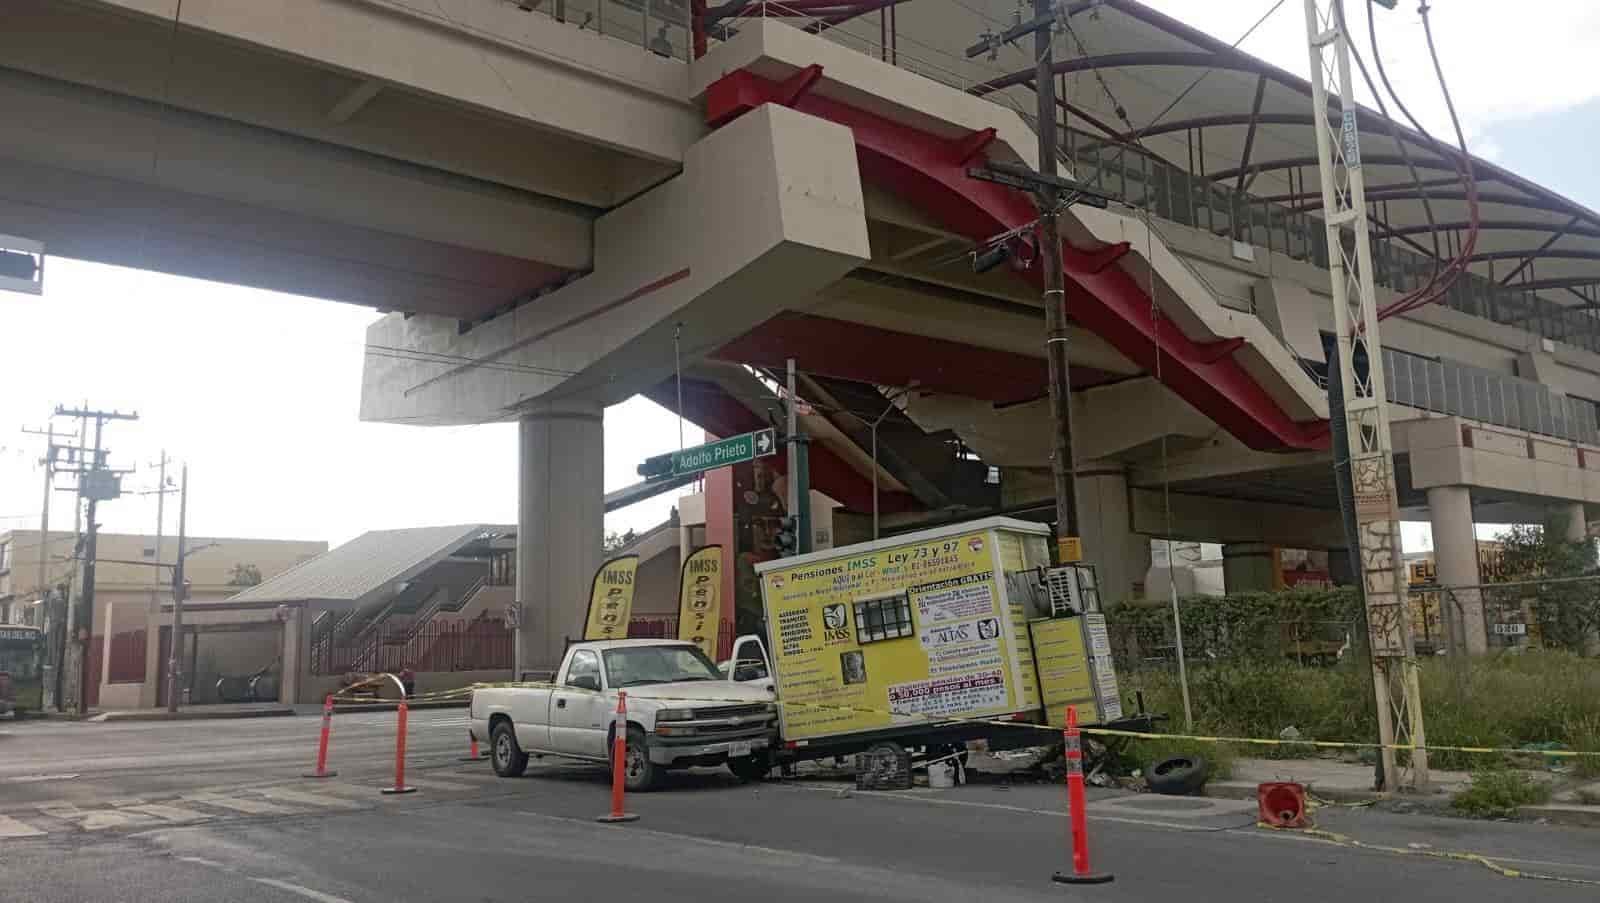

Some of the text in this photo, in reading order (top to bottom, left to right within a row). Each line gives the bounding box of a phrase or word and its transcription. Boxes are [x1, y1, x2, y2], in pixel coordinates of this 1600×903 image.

[680, 443, 746, 468] Adolfo Prieto
[690, 559, 718, 574] IMSS
[791, 541, 959, 582] Pensiones IMSS Ley 73 y 97
[603, 570, 632, 585] IMSS
[938, 629, 969, 642] ALTAS
